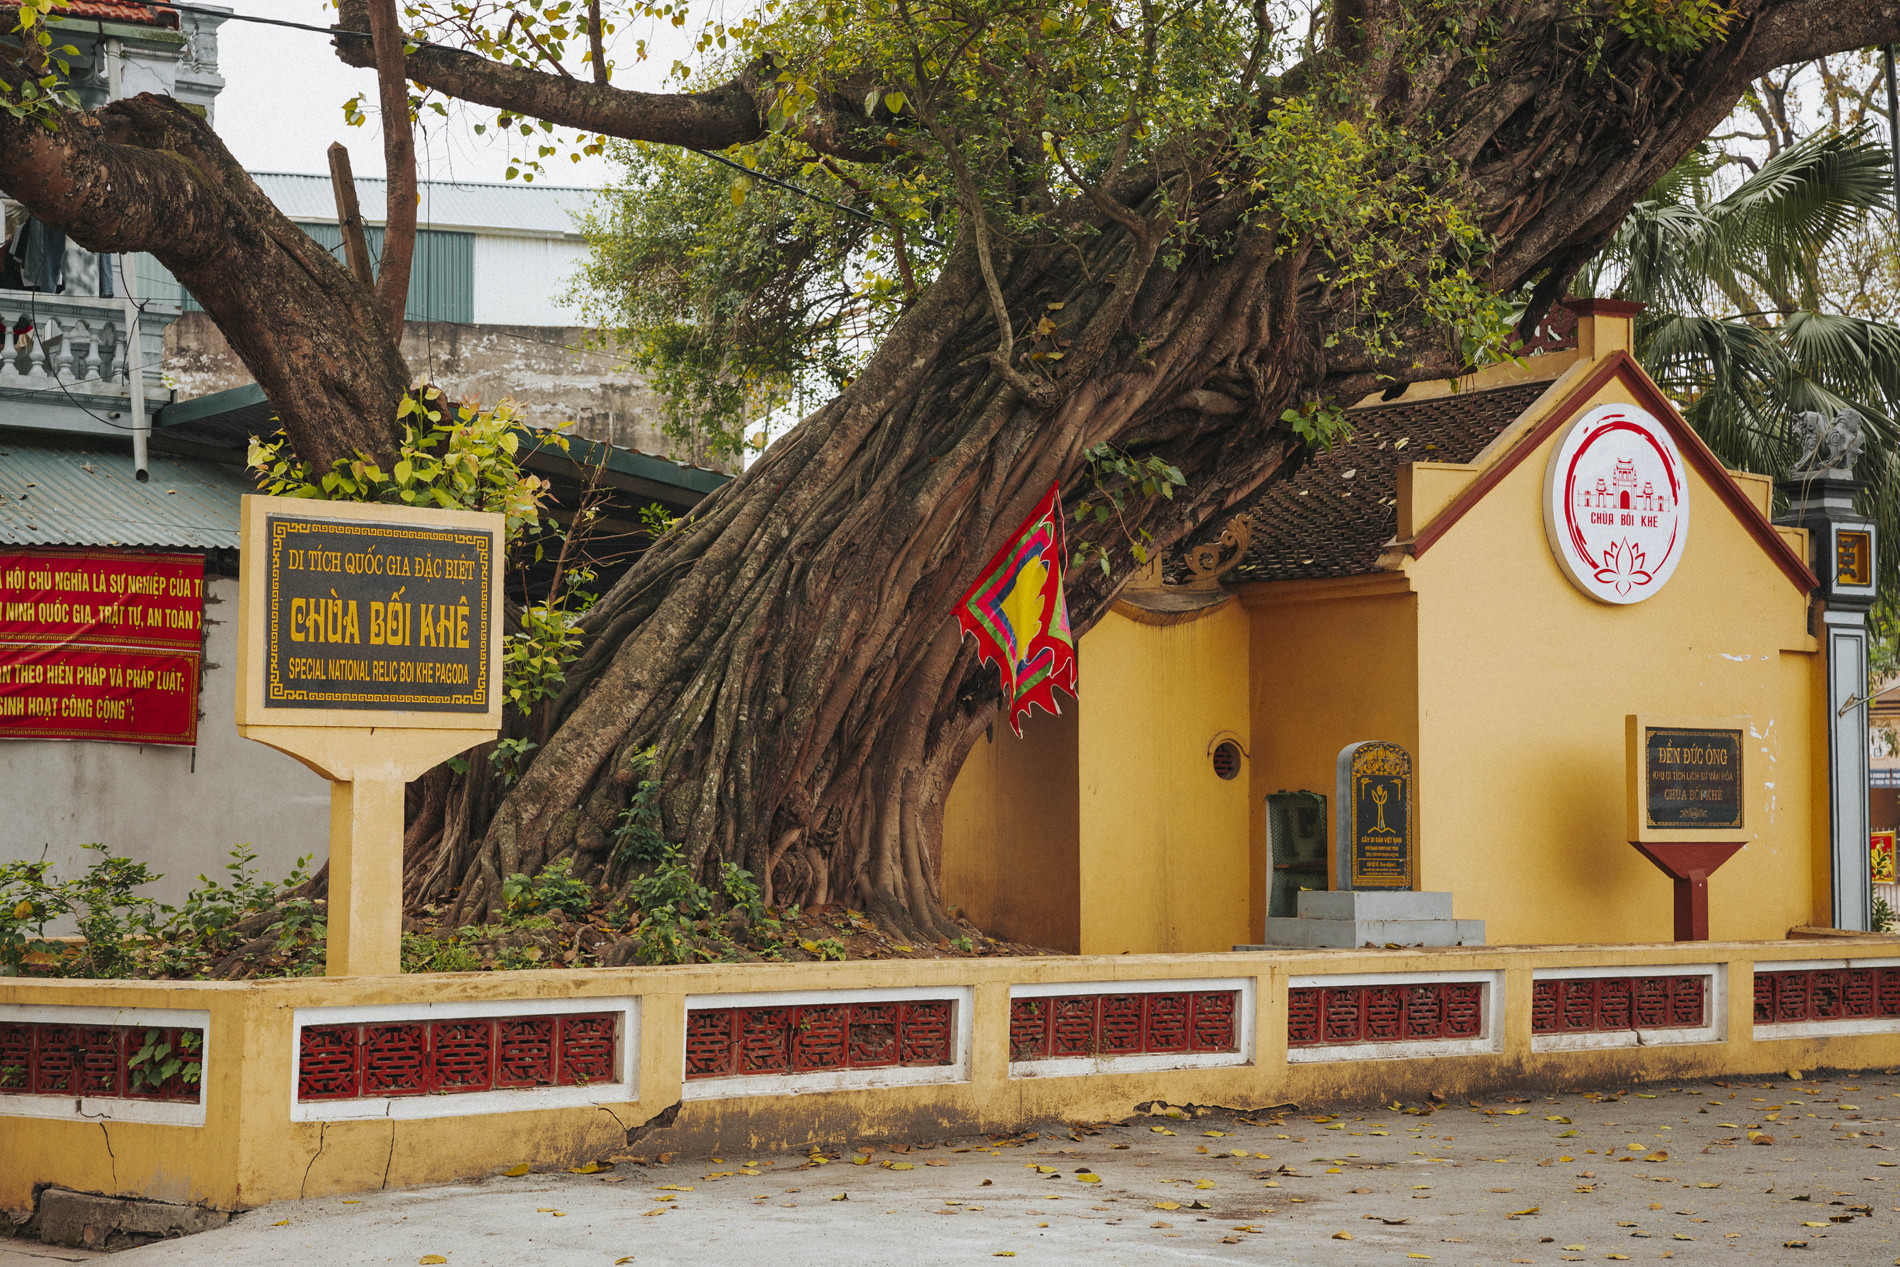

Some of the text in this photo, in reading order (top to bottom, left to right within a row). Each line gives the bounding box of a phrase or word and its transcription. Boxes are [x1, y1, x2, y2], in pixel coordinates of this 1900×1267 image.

[1590, 511, 1614, 526] CHÙA
[1621, 511, 1634, 526] BỐI
[288, 544, 475, 585] DI TÍCH QUỐC GIA ĐẶC BIỆT
[6, 566, 25, 594] HỘI
[28, 563, 52, 590] CHỦ
[55, 569, 90, 592] NGHĨA
[93, 569, 106, 592] LÀ
[110, 573, 126, 598] SỰ
[128, 572, 166, 599] NGHIỆP
[170, 570, 191, 598] CỦA
[194, 578, 203, 598] T
[6, 602, 34, 622] NINH
[38, 597, 69, 624] QUỐC
[72, 604, 95, 625] GIA,
[98, 602, 124, 628] TRẬT
[128, 605, 144, 630] TỰ,
[147, 608, 162, 627] AN
[165, 606, 193, 629] TOÀN
[290, 586, 470, 648] CHÙA BỐI KHÊ
[15, 665, 43, 684] THEO
[47, 658, 73, 684] HIẾN
[76, 663, 106, 686] PHÁP
[110, 664, 123, 687] VÀ
[126, 666, 154, 688] PHÁP
[157, 668, 184, 695] LUẬT;
[288, 658, 469, 684] SPECIAL NATIONAL RELIC BOI KHE PAGODA
[28, 696, 58, 721] HOẠT
[62, 694, 92, 718] CÔNG
[1659, 738, 1728, 765] ĐỀN ĐỨC ÔNG
[1664, 786, 1687, 800] CHÙA
